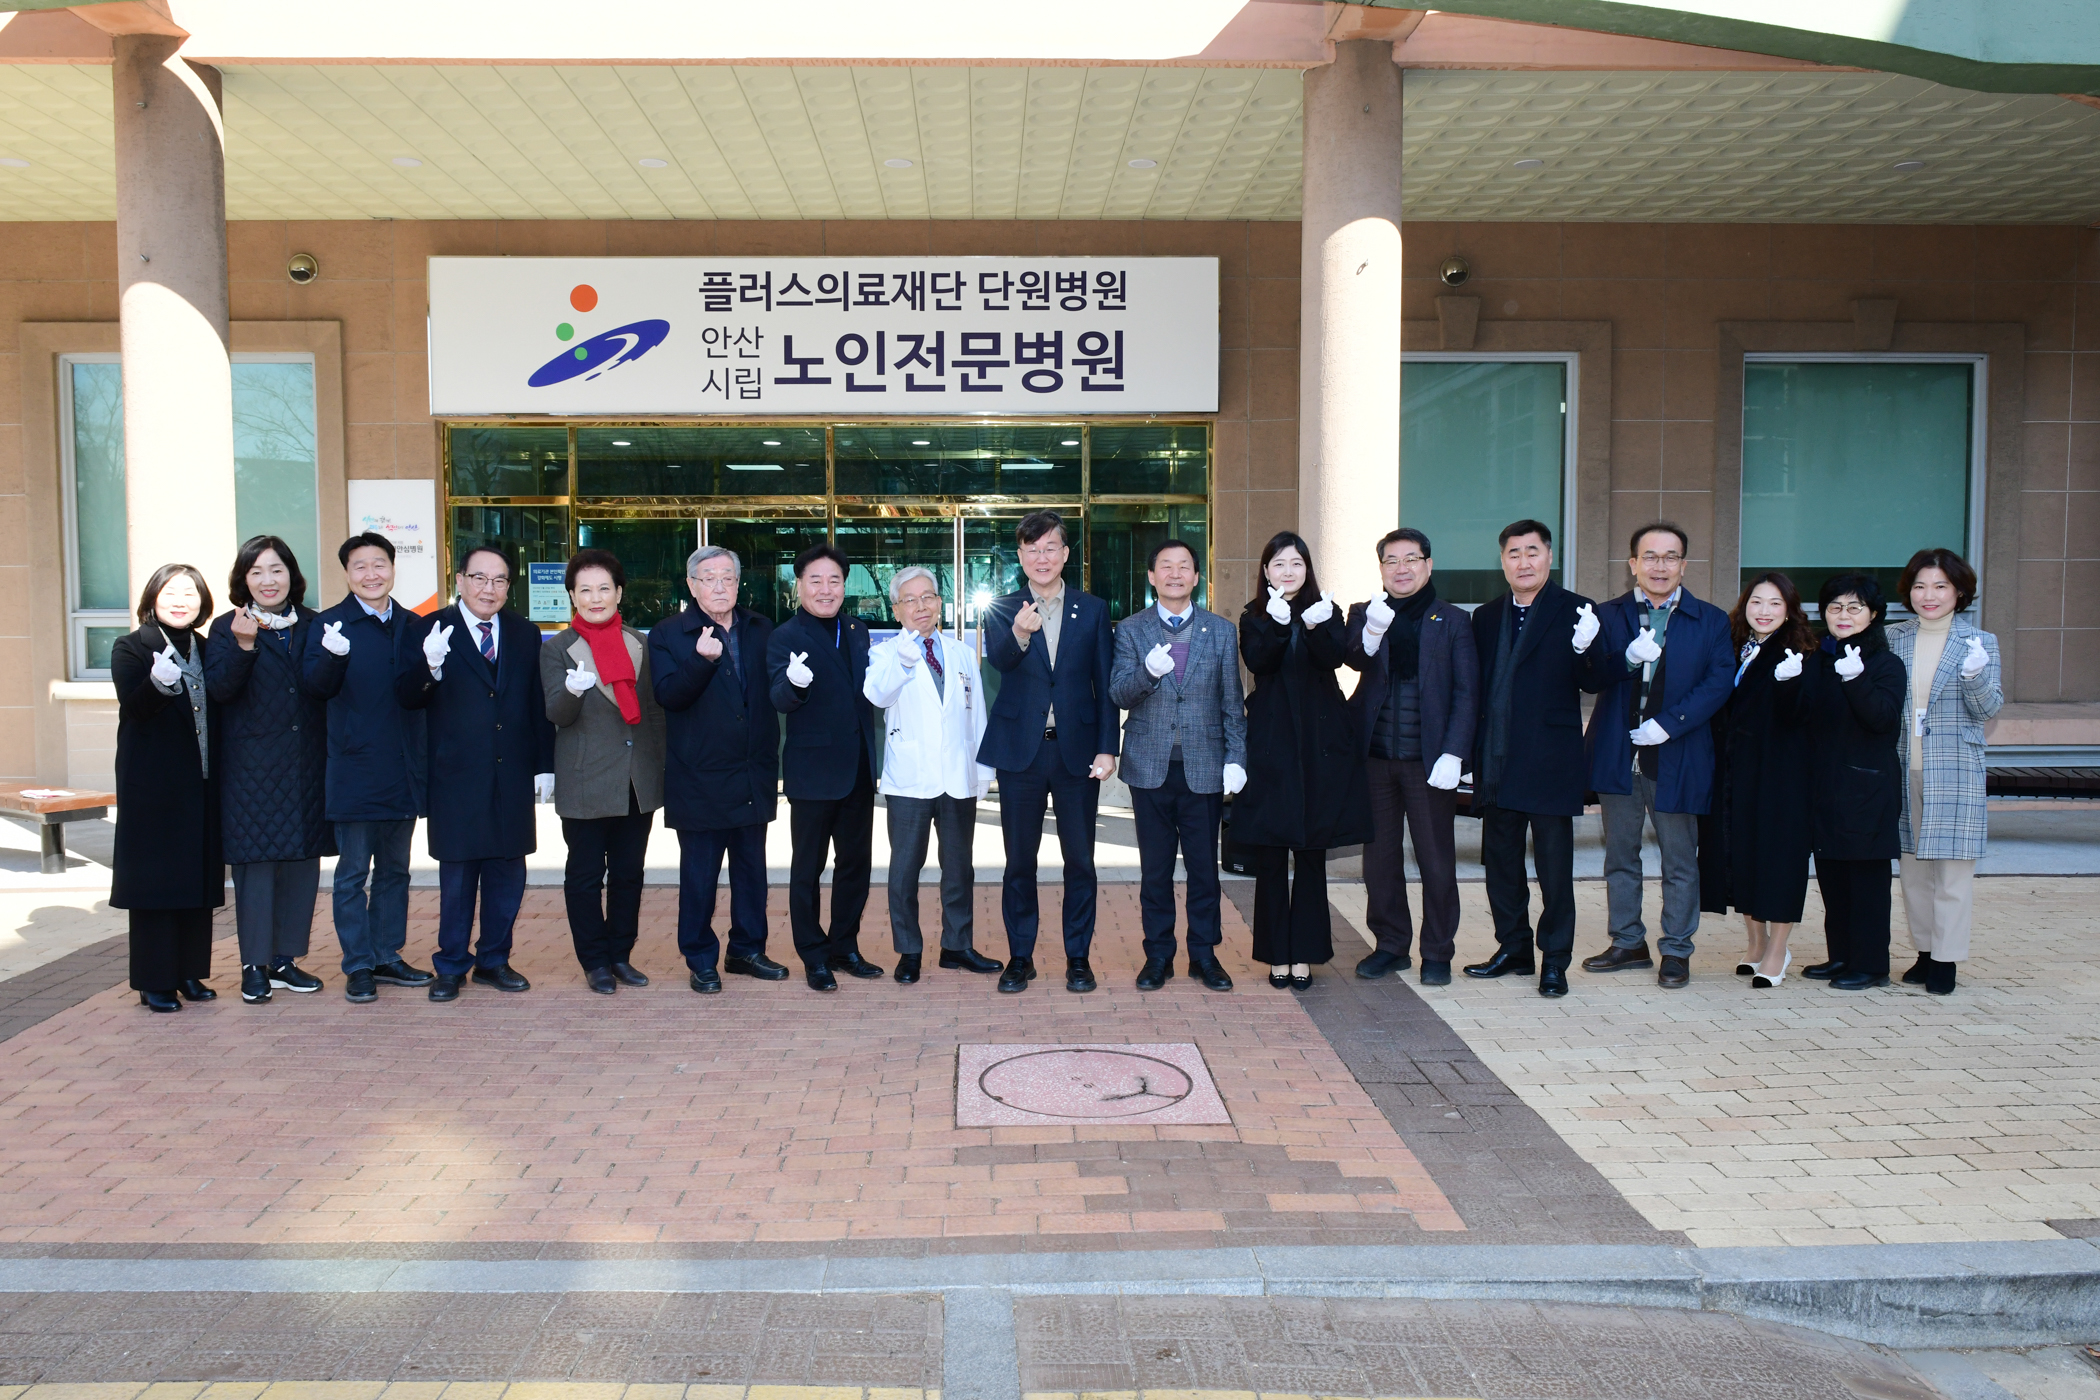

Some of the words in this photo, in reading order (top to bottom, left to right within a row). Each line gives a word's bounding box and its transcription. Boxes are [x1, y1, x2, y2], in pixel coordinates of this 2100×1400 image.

[698, 270, 967, 312] 플러스의료재단
[978, 270, 1127, 312] 단원병원
[701, 325, 765, 359] 안산
[773, 330, 1125, 394] 노인전문병원
[701, 367, 761, 400] 시립
